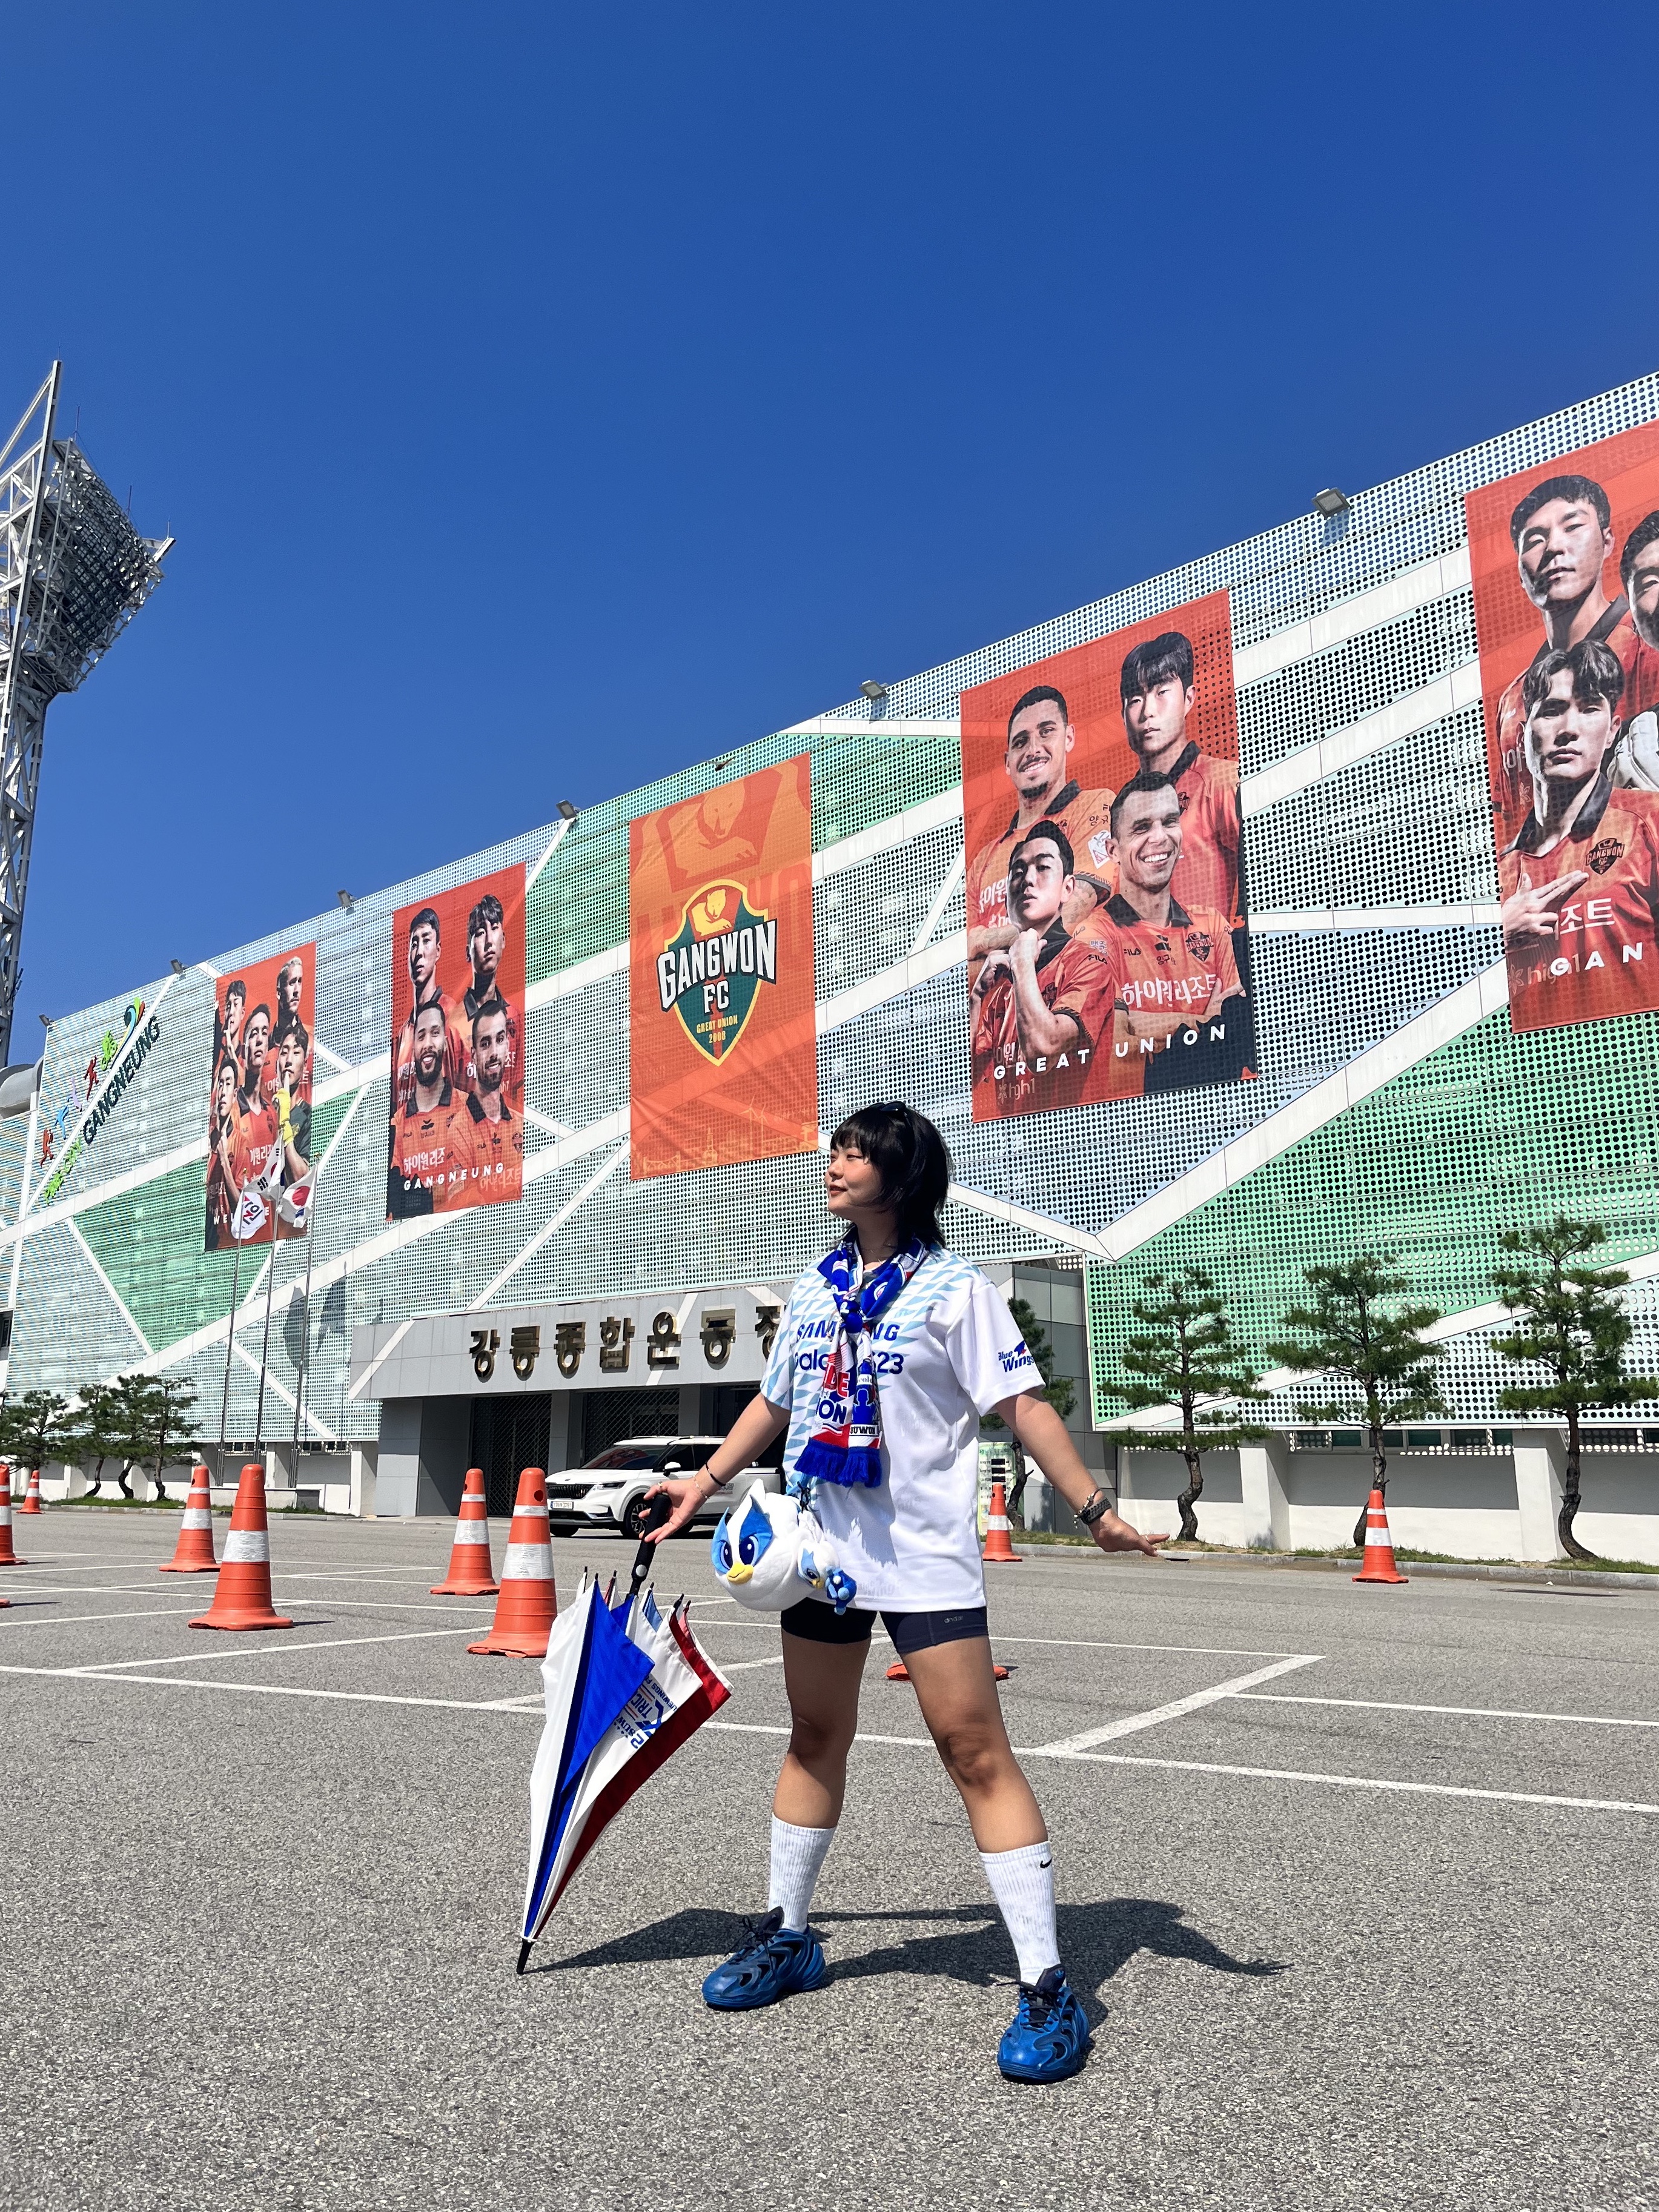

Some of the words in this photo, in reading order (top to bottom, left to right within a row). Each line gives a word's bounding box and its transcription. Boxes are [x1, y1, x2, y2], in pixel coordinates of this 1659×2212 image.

[657, 919, 777, 1012] GANGWON
[1088, 954, 1108, 965] FILA
[703, 980, 729, 1014] FC
[1121, 973, 1217, 1008] 하이원리조트
[696, 1019, 717, 1034] GREAT
[717, 1015, 738, 1029] UNION
[709, 1030, 726, 1044] 2008
[993, 1048, 1090, 1080] GREAT
[1115, 1024, 1225, 1058] UNION
[82, 1015, 161, 1145] GANGNEUNG
[403, 1147, 446, 1175] 하이원리조
[403, 1162, 503, 1191] GANGNEUNG
[796, 1319, 901, 1342] SAMNG
[998, 1351, 1013, 1362] Blue
[1002, 1355, 1035, 1373] Wings
[630, 1692, 653, 1720] TRIC
